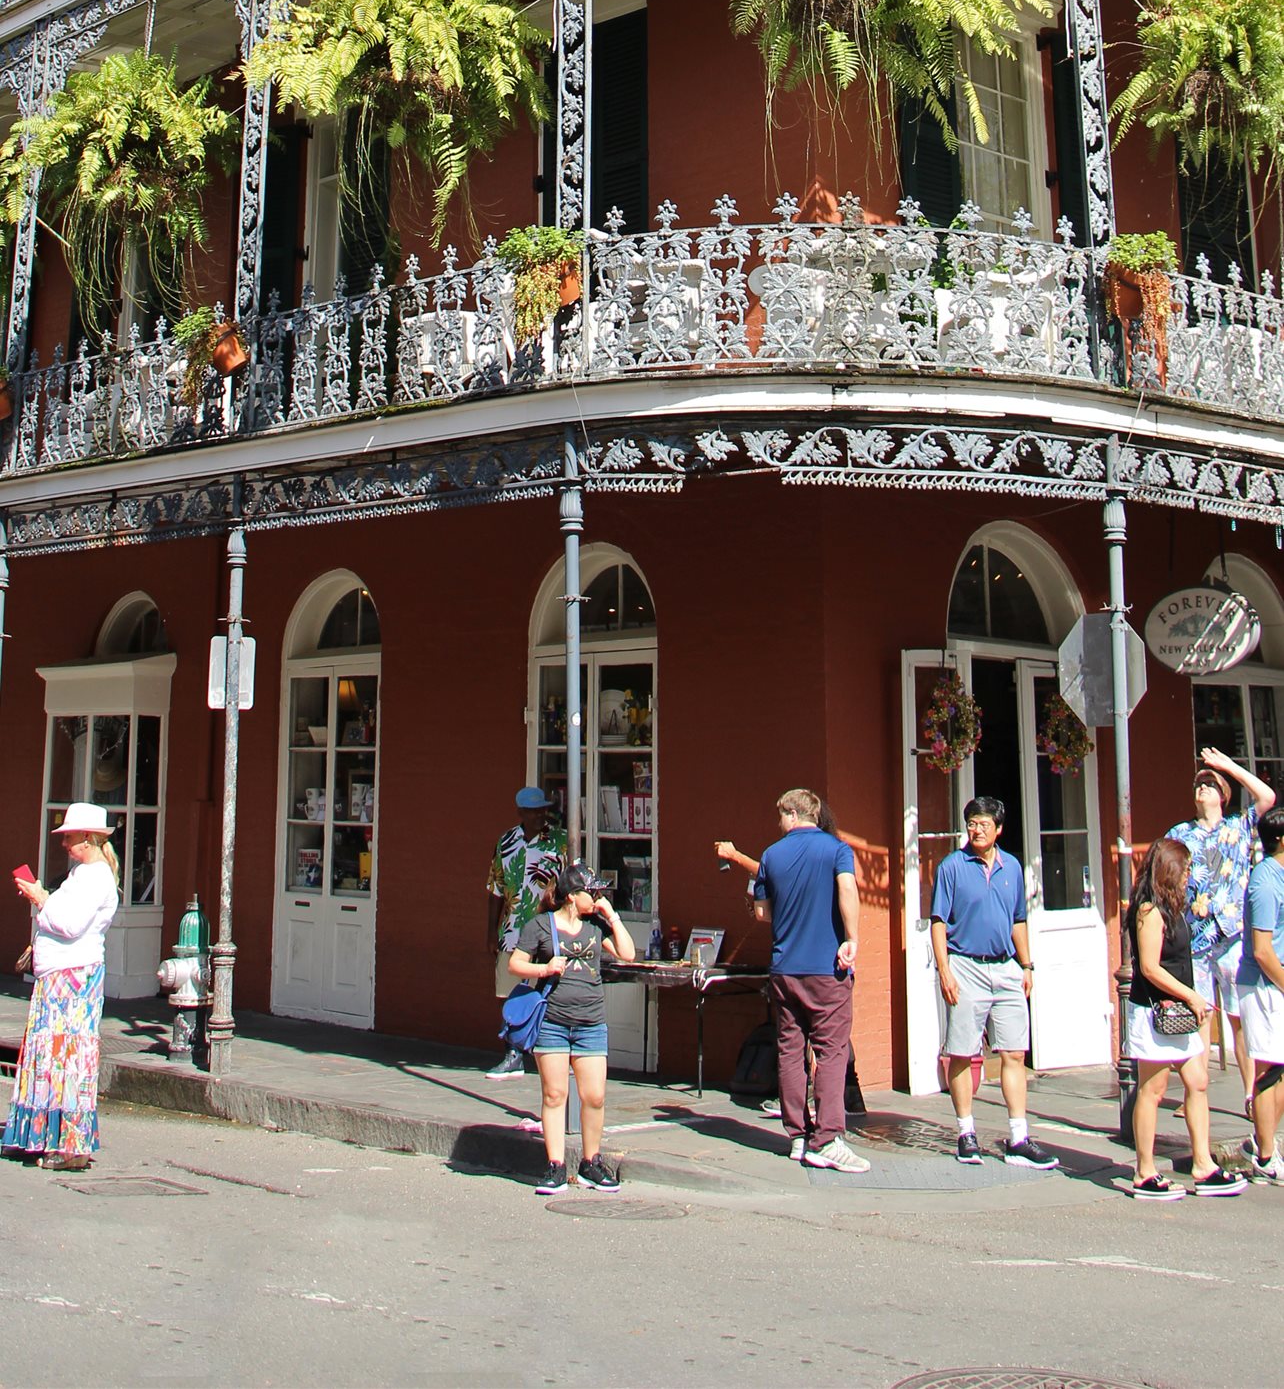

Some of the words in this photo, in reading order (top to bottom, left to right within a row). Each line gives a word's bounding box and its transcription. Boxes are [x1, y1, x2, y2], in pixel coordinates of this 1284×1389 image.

[1159, 645, 1183, 654] NEW
[572, 942, 582, 952] N
[573, 959, 583, 971] A
